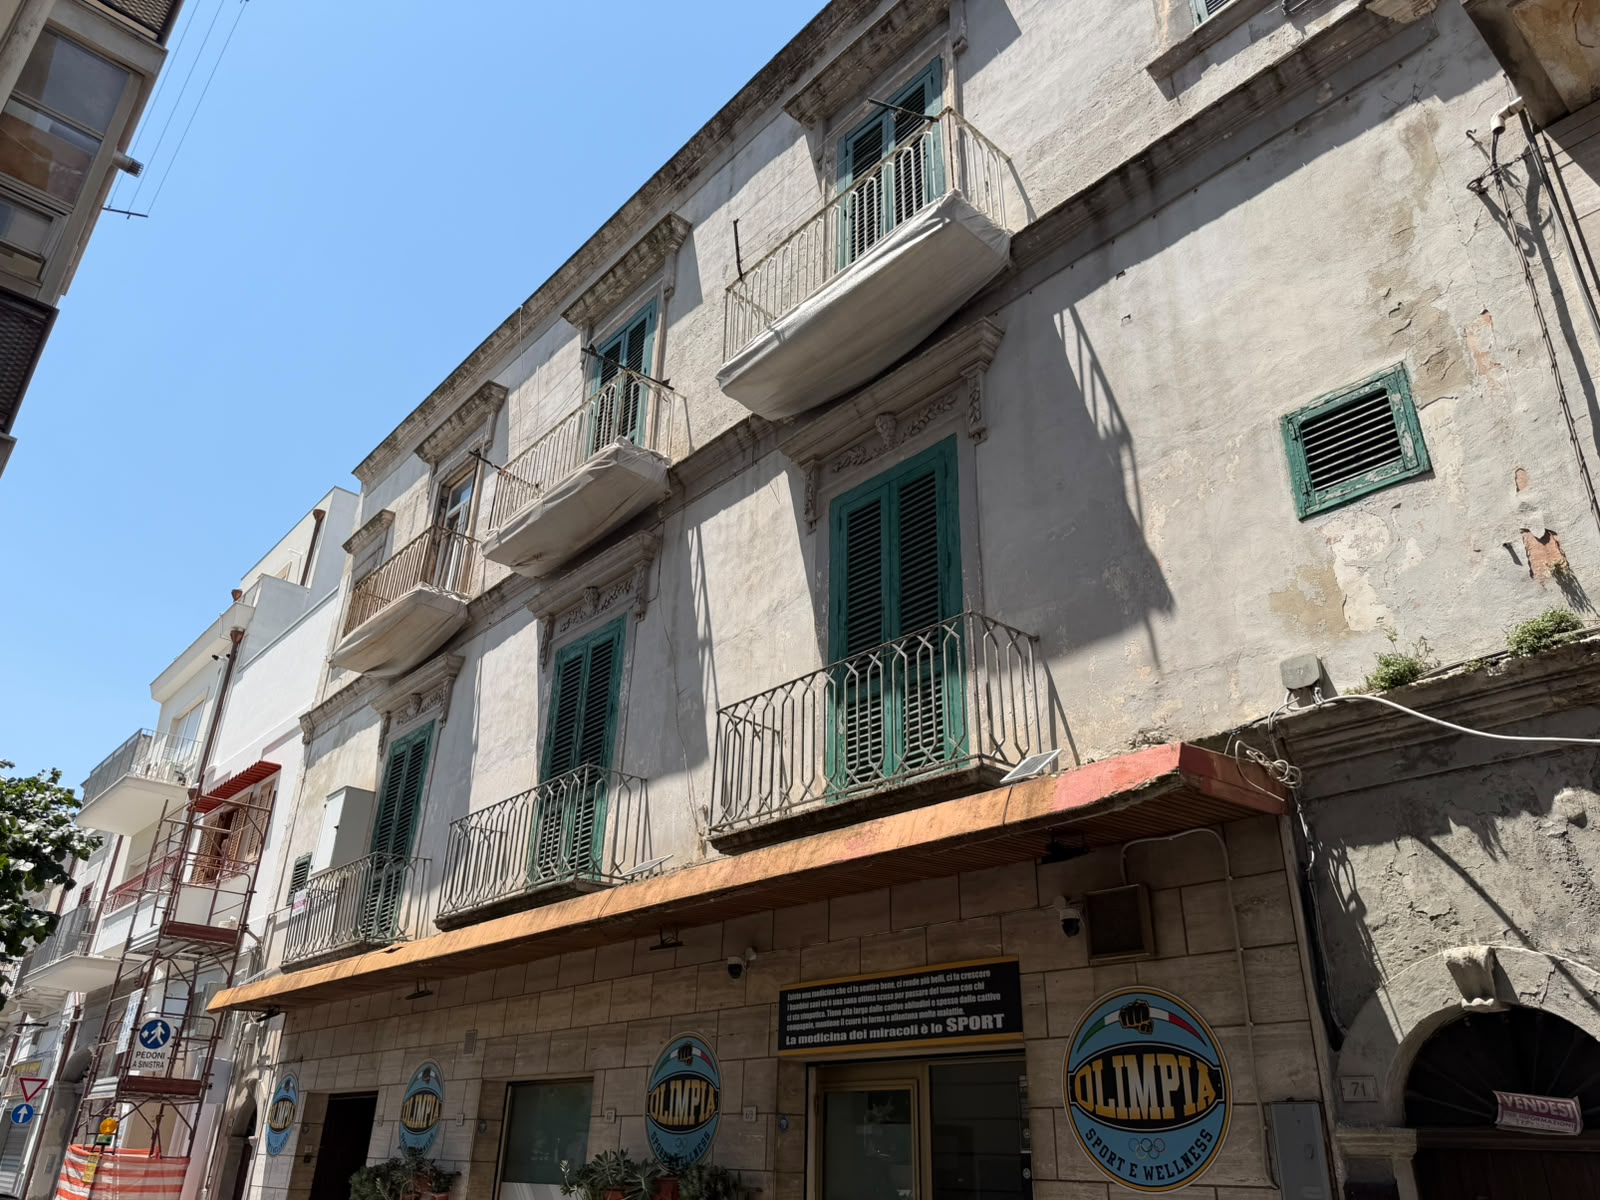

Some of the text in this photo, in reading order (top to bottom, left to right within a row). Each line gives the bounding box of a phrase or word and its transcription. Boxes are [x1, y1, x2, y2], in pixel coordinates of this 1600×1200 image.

[811, 987, 835, 997] medicina
[836, 986, 845, 994] che
[846, 985, 852, 993] ci
[896, 979, 902, 988] ci
[946, 973, 952, 982] ci
[953, 972, 959, 981] fa
[876, 991, 893, 1001] scusa
[894, 990, 904, 999] per
[929, 986, 938, 995] del
[939, 984, 959, 994] tempo
[960, 982, 972, 992] con
[973, 981, 984, 990] chi
[959, 994, 976, 1004] dalle
[785, 1012, 1004, 1045] La medicina dei miracoli è lo SPORT
[136, 1051, 165, 1059] PEDONI
[1074, 1052, 1217, 1120] OLIMPIA
[1351, 1082, 1366, 1096] 71
[402, 1094, 440, 1128] OLIMPIA
[650, 1080, 716, 1126] OLIMPIA
[1502, 1094, 1574, 1119] VENDESI
[1519, 1113, 1576, 1128] INFORMAZIONI
[1086, 1128, 1213, 1180] SPORT E WELLNESS
